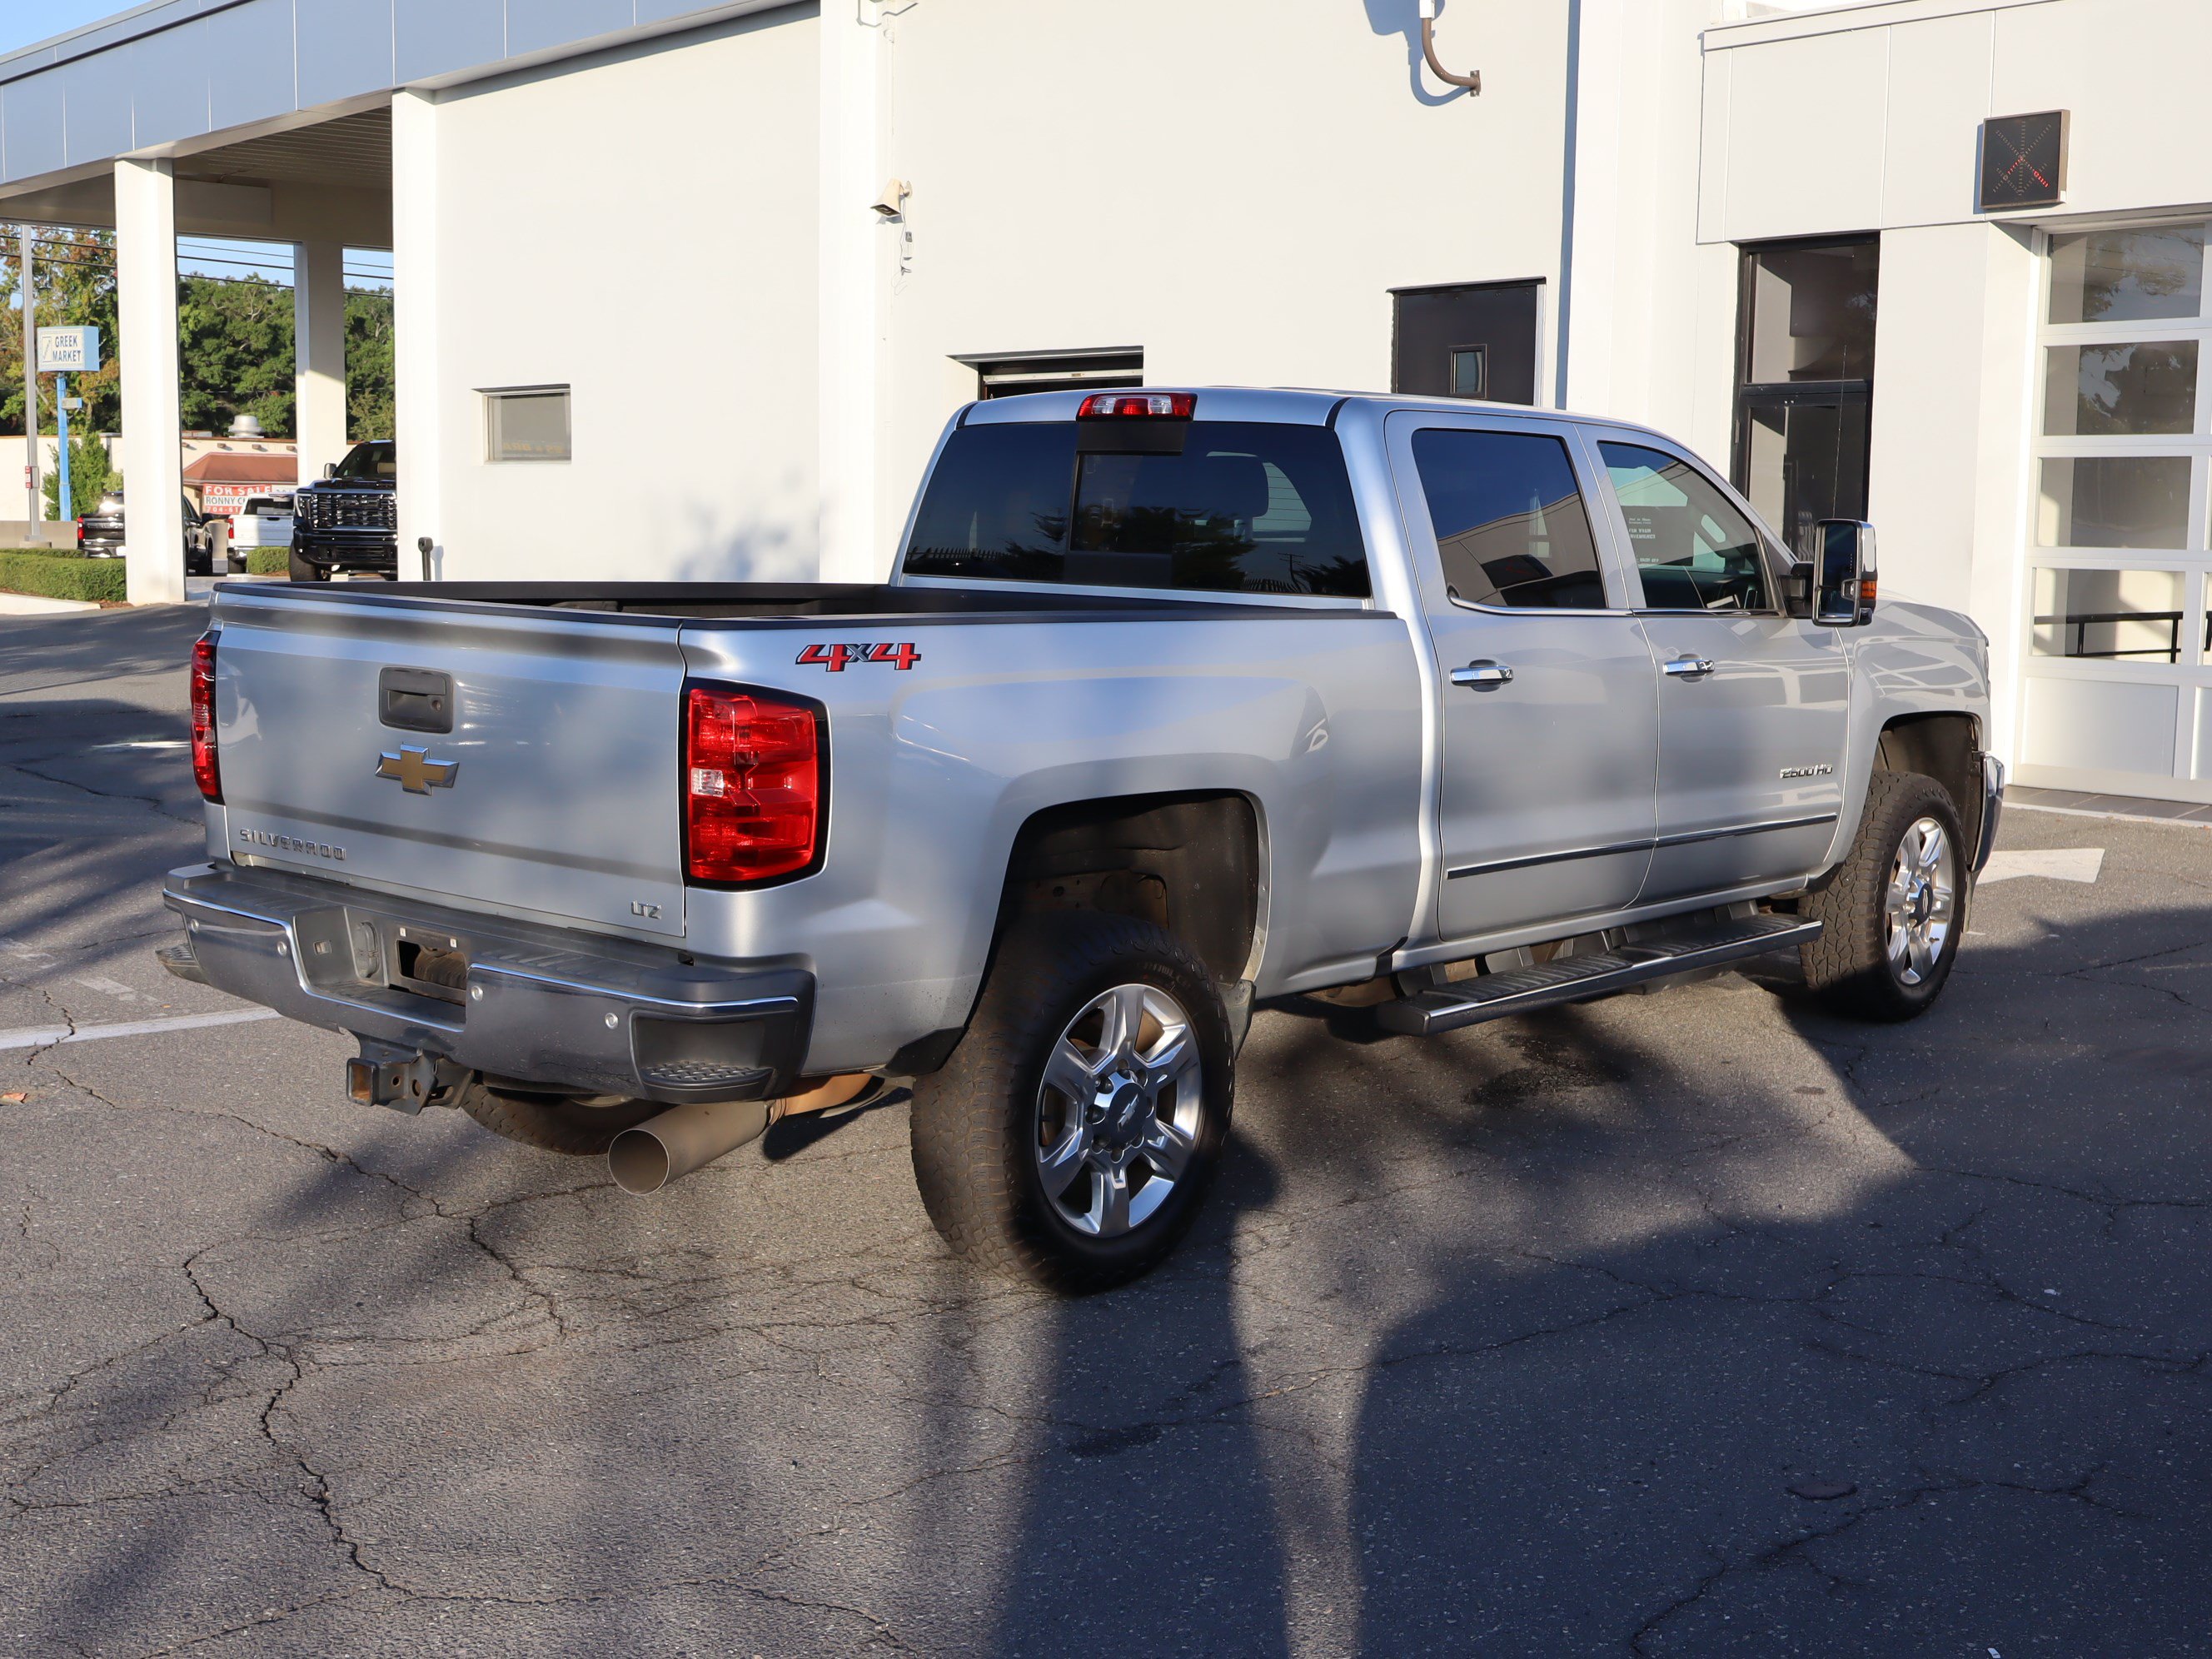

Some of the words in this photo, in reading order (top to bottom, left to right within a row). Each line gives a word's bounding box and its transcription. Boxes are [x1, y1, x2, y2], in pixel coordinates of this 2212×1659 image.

[55, 336, 77, 347] GREEK
[53, 351, 81, 361] MARKET
[205, 486, 233, 496] FOR
[206, 496, 236, 505] RONNY
[240, 829, 346, 860] SILVERADO
[631, 900, 661, 919] LTZ
